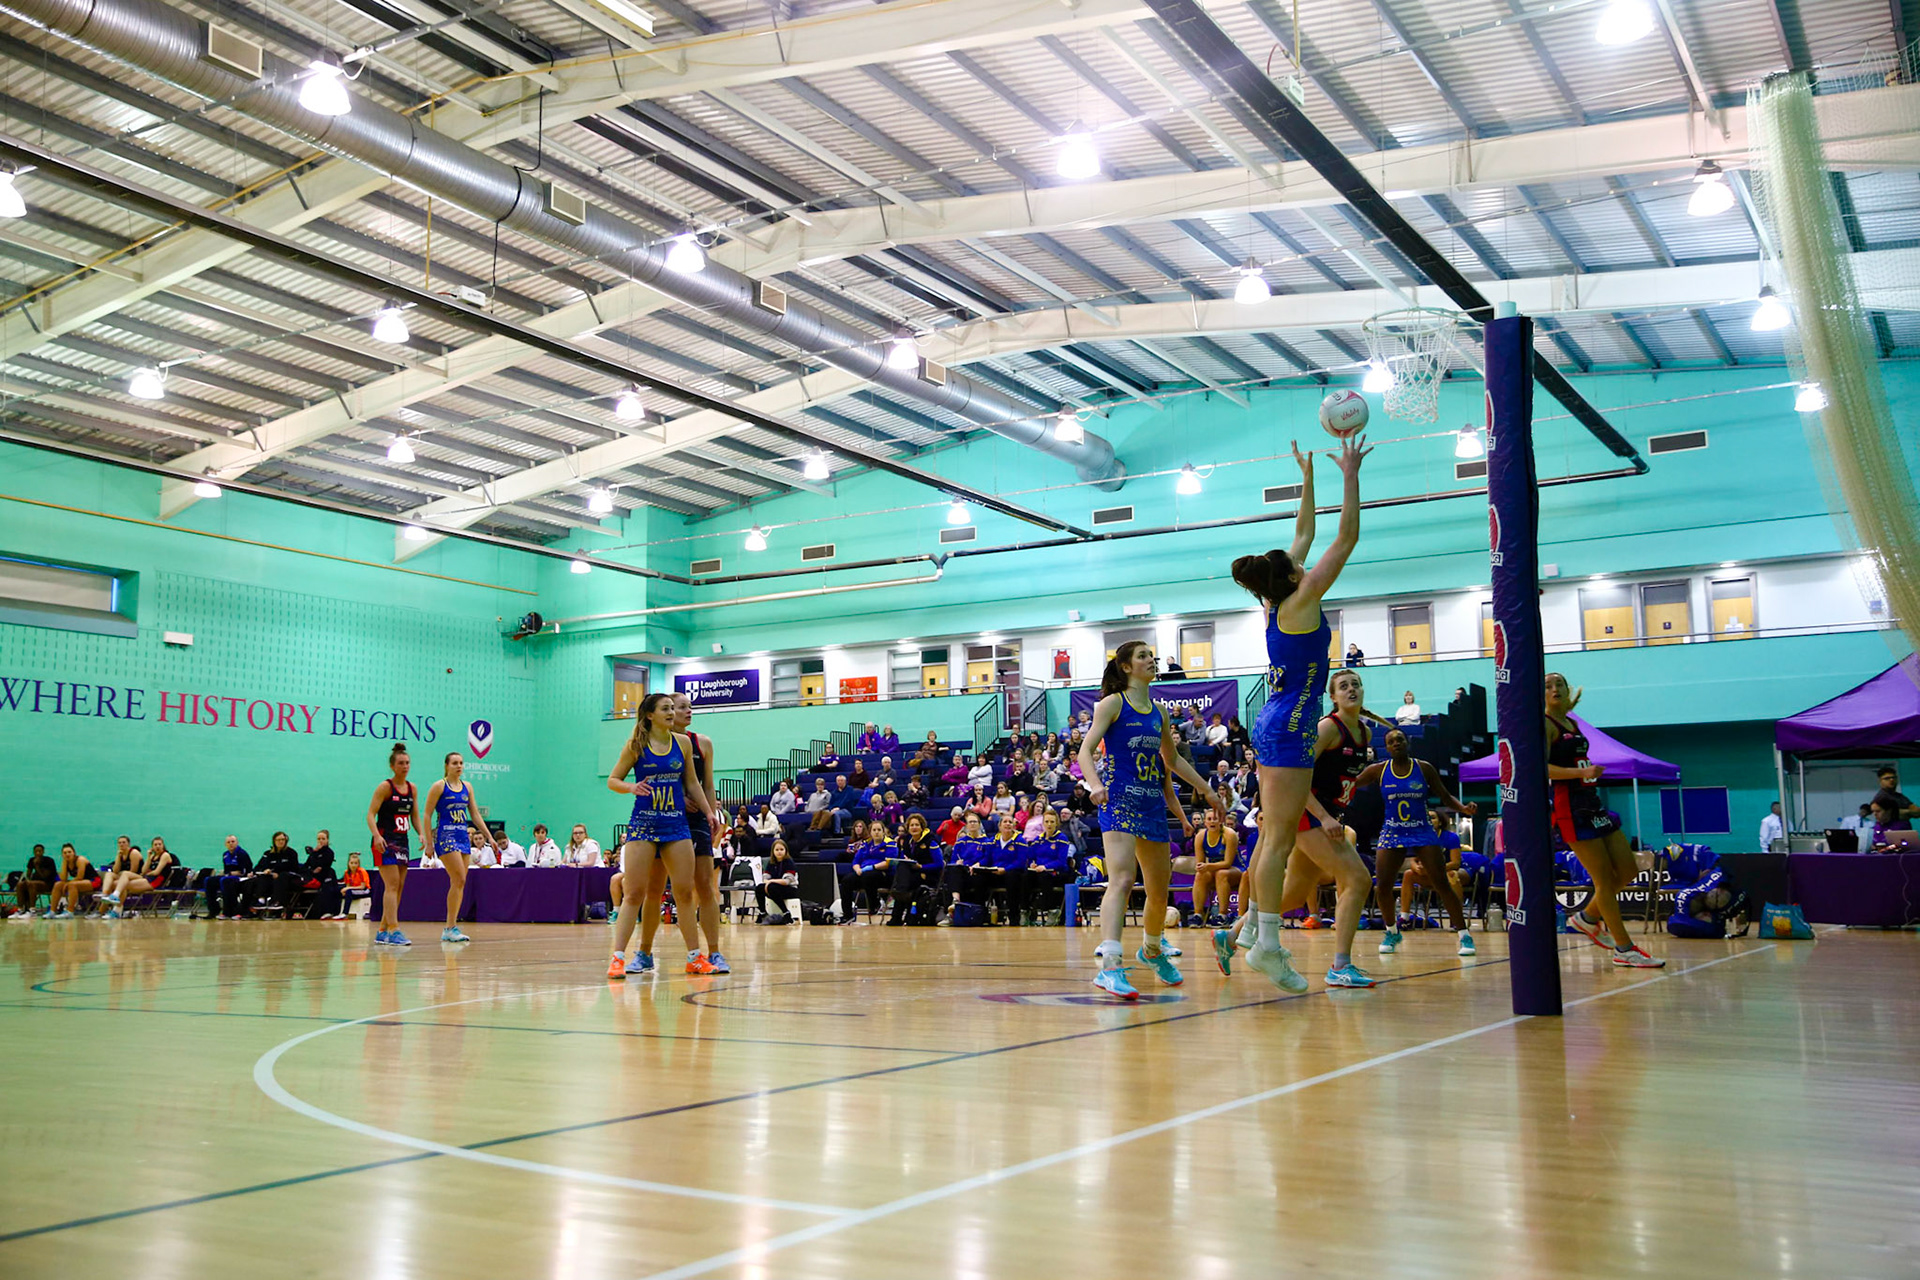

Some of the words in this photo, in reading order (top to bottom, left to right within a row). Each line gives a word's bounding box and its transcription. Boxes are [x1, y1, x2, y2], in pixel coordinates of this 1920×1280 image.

[700, 677, 748, 690] Loughborough
[700, 688, 734, 698] University
[0, 677, 146, 721] WHERE
[157, 691, 321, 734] HISTORY
[330, 708, 436, 743] BEGINS
[1136, 752, 1160, 781] GA
[651, 785, 675, 811] WA
[1397, 800, 1411, 822] C
